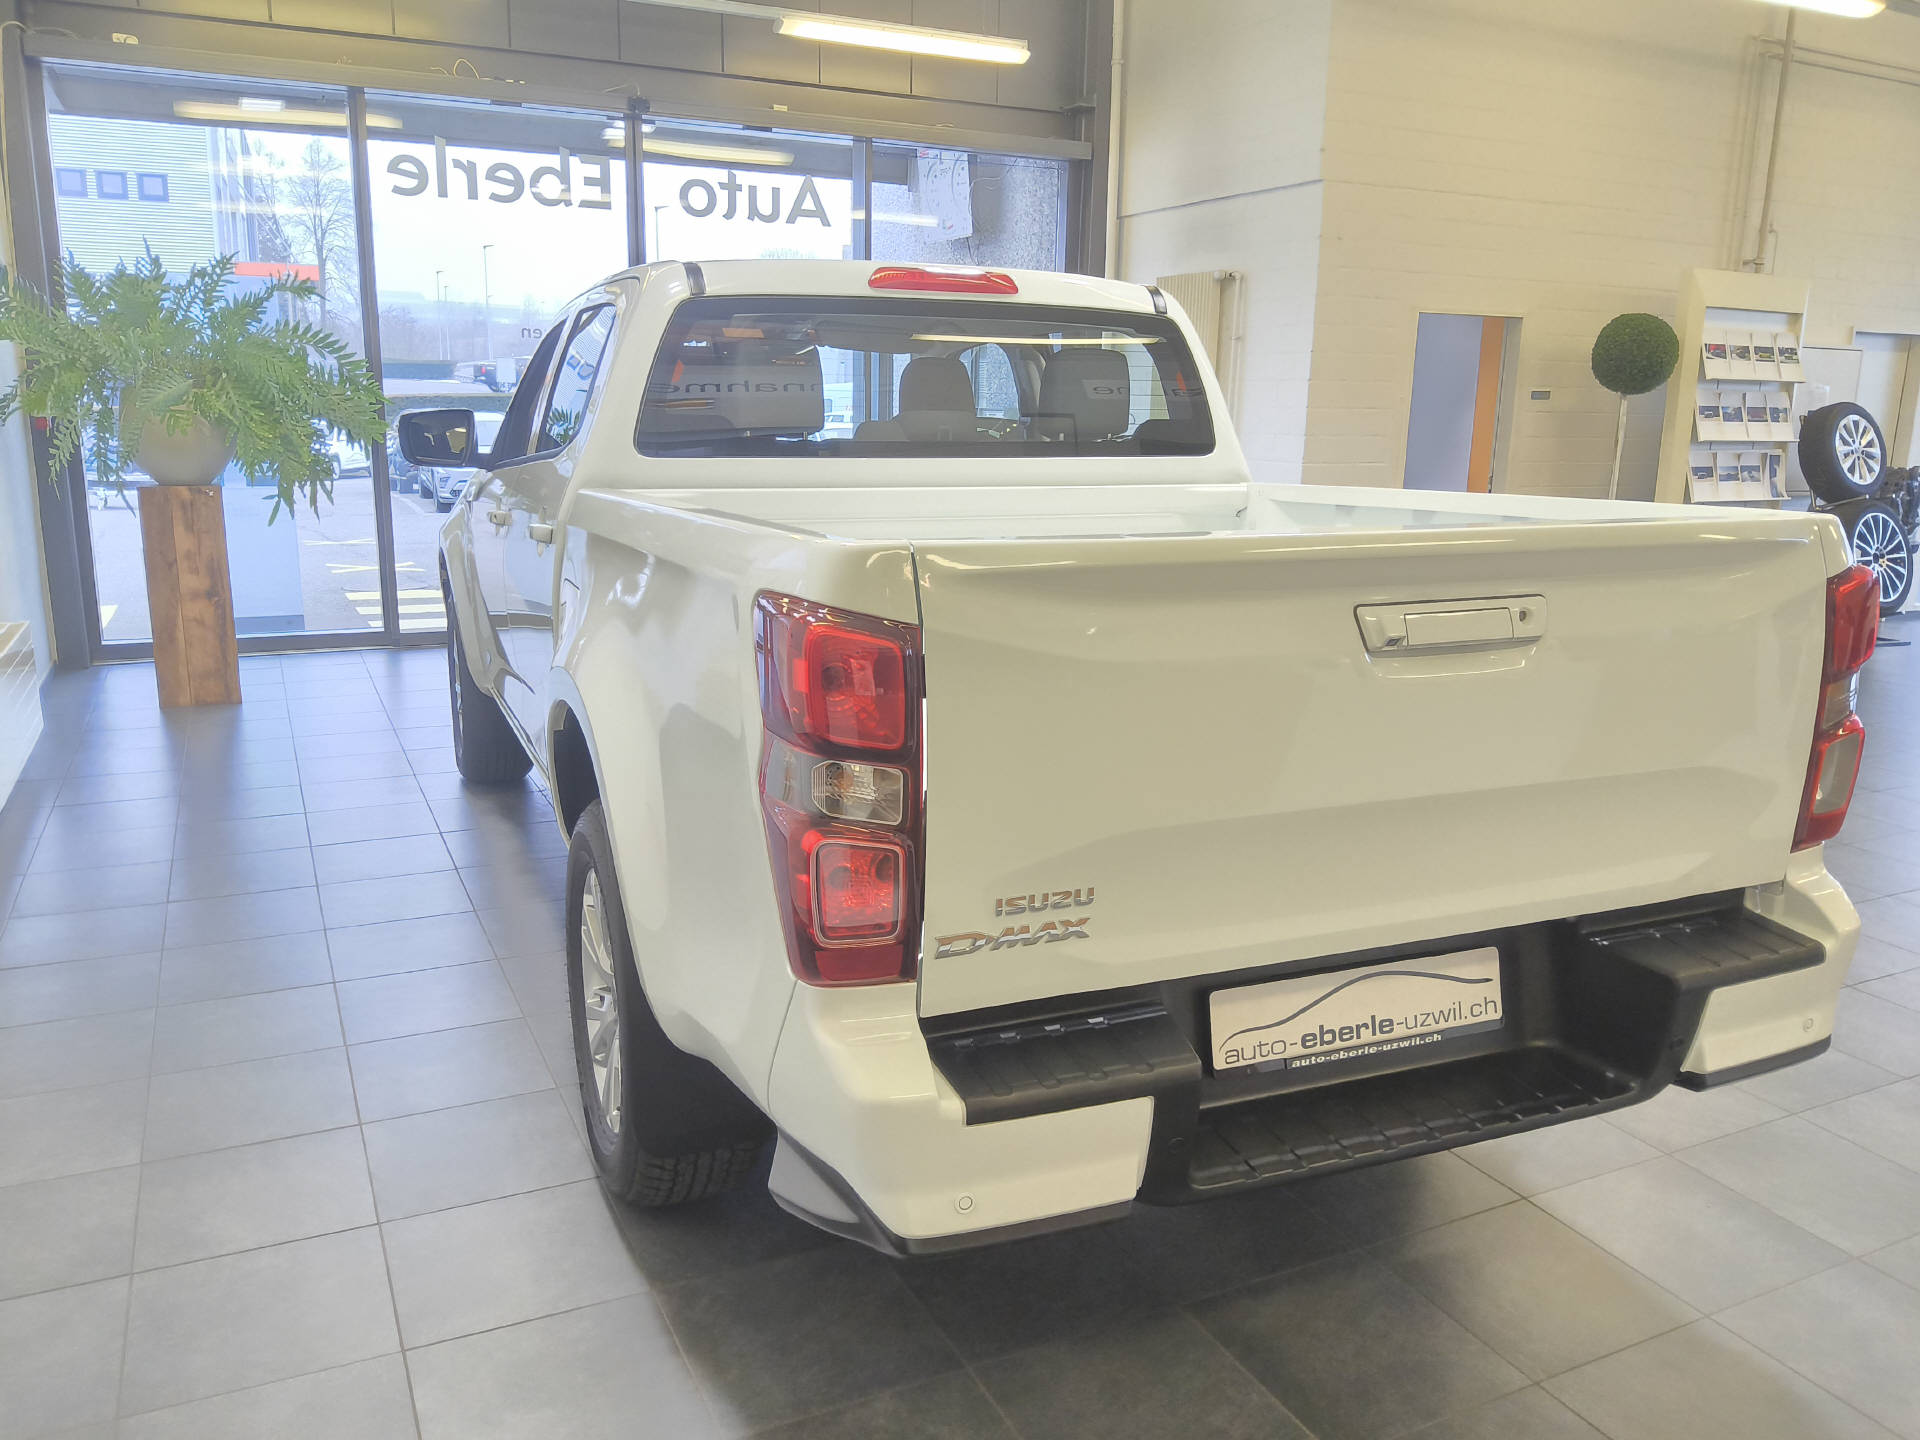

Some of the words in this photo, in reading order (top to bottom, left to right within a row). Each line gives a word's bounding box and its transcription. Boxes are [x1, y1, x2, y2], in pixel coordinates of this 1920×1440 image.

[995, 887, 1095, 917] ISUZU
[1224, 996, 1498, 1065] auto-eberle-uzwil.ch
[1291, 1032, 1442, 1068] auto-eberle-uzwil.ch
